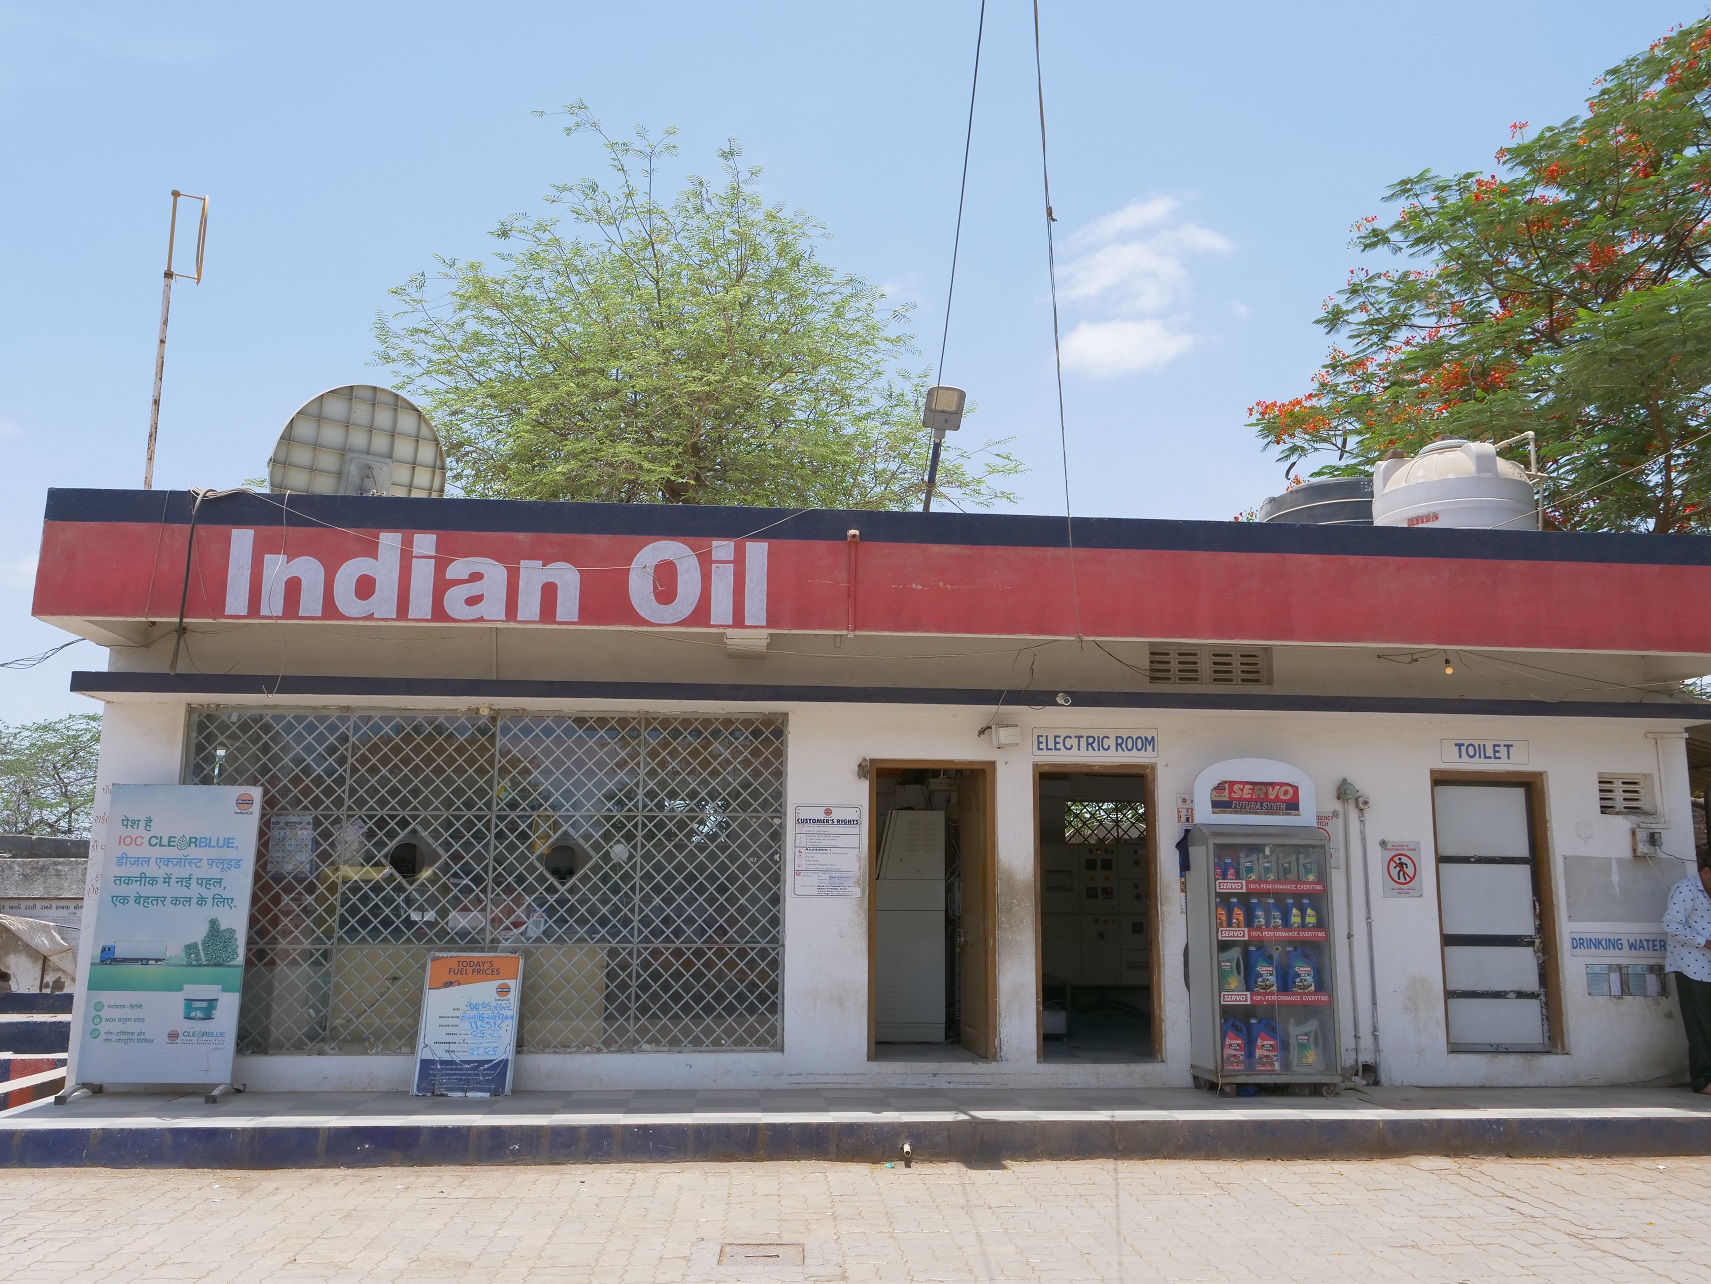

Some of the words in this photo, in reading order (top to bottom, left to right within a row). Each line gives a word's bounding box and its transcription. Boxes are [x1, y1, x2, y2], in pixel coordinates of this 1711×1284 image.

[224, 528, 580, 622] Indian
[628, 539, 769, 626] Oil
[1036, 734, 1111, 752] ELECTRIC
[1114, 735, 1156, 753] ROOM
[1454, 742, 1514, 760] TOILET
[1230, 783, 1294, 800] SERVO
[1232, 801, 1261, 809] FUTURA
[1262, 802, 1286, 810] SYNTH
[121, 814, 141, 830] पेश
[144, 815, 153, 831] है
[118, 834, 144, 846] IOC
[115, 852, 152, 867] डीज़ल
[154, 853, 203, 869] एक्ज़ॉस्ट
[206, 857, 242, 873] फ़्लूइड
[113, 872, 159, 887] तकनीक
[162, 872, 172, 887] में
[175, 873, 193, 889] नई
[196, 877, 227, 891] पहल,
[110, 895, 131, 908] एक
[133, 891, 168, 908] बेहतर
[170, 896, 193, 907] कल
[196, 892, 208, 907] के
[211, 893, 237, 910] लिए.
[1571, 937, 1623, 951] DRINKING
[1626, 938, 1667, 952] WATER
[448, 967, 469, 975] FUEL
[471, 968, 501, 976] PRICES
[456, 960, 494, 968] TODAY'S
